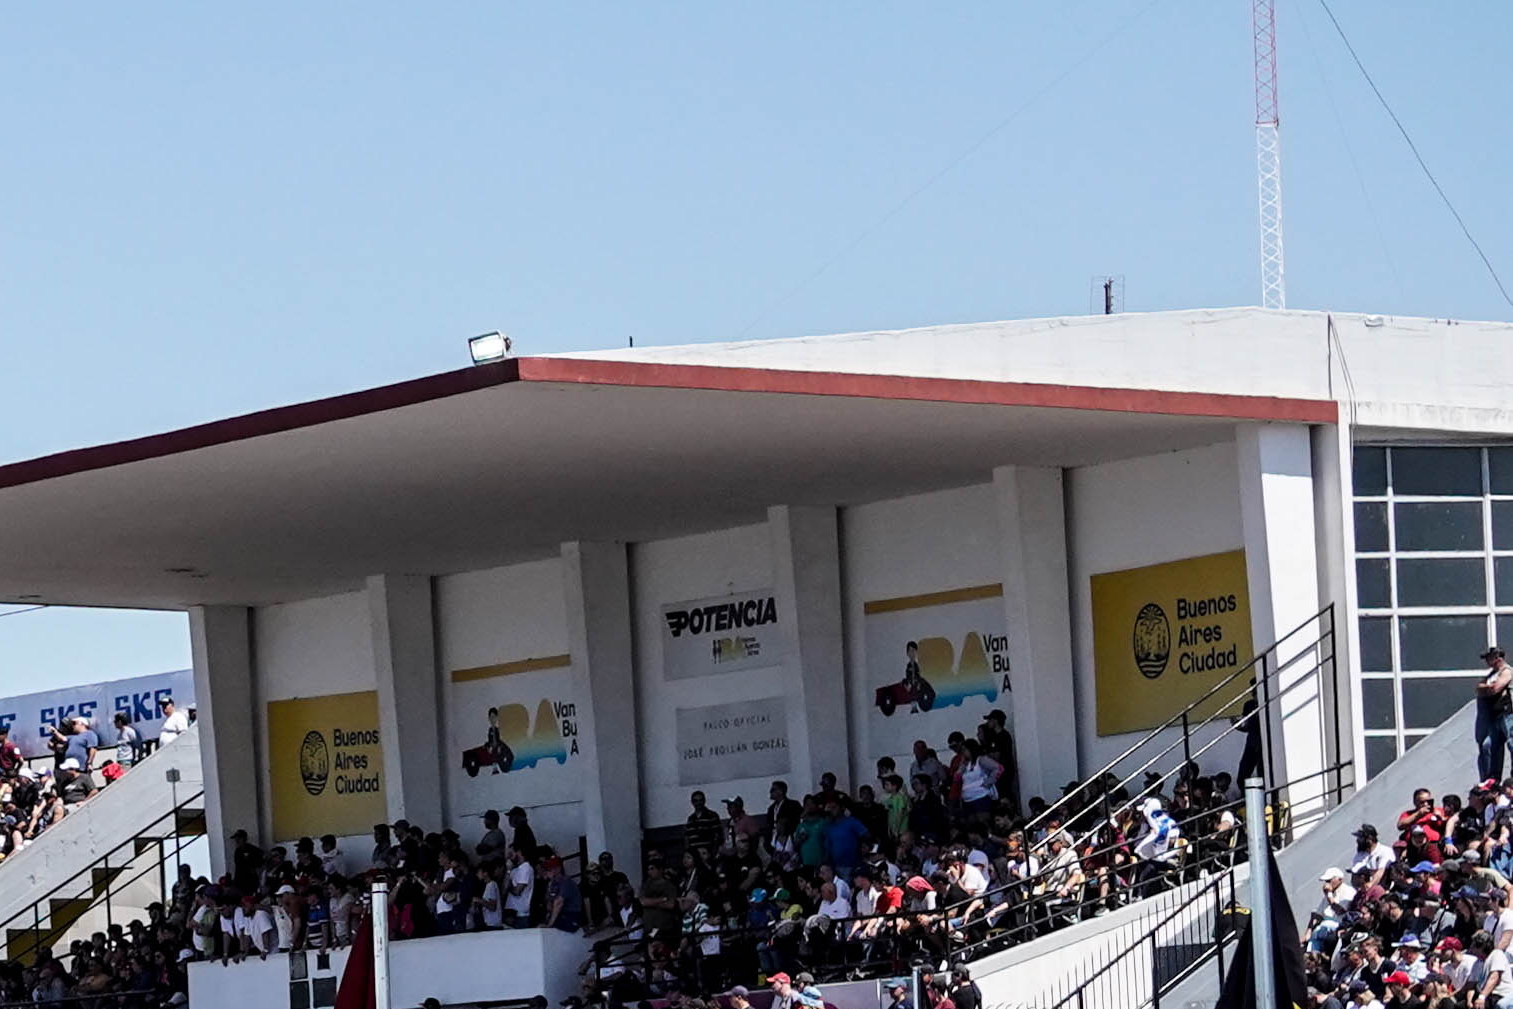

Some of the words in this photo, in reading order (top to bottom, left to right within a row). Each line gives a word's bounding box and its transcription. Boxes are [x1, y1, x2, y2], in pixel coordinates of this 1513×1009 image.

[665, 597, 777, 637] POTENCIA
[1177, 593, 1236, 620] Buenos
[1179, 623, 1222, 648] Aires
[1179, 645, 1237, 675] Ciudad
[333, 728, 379, 747] Buenos
[334, 753, 368, 768] Aires
[335, 774, 379, 794] Ciudad
